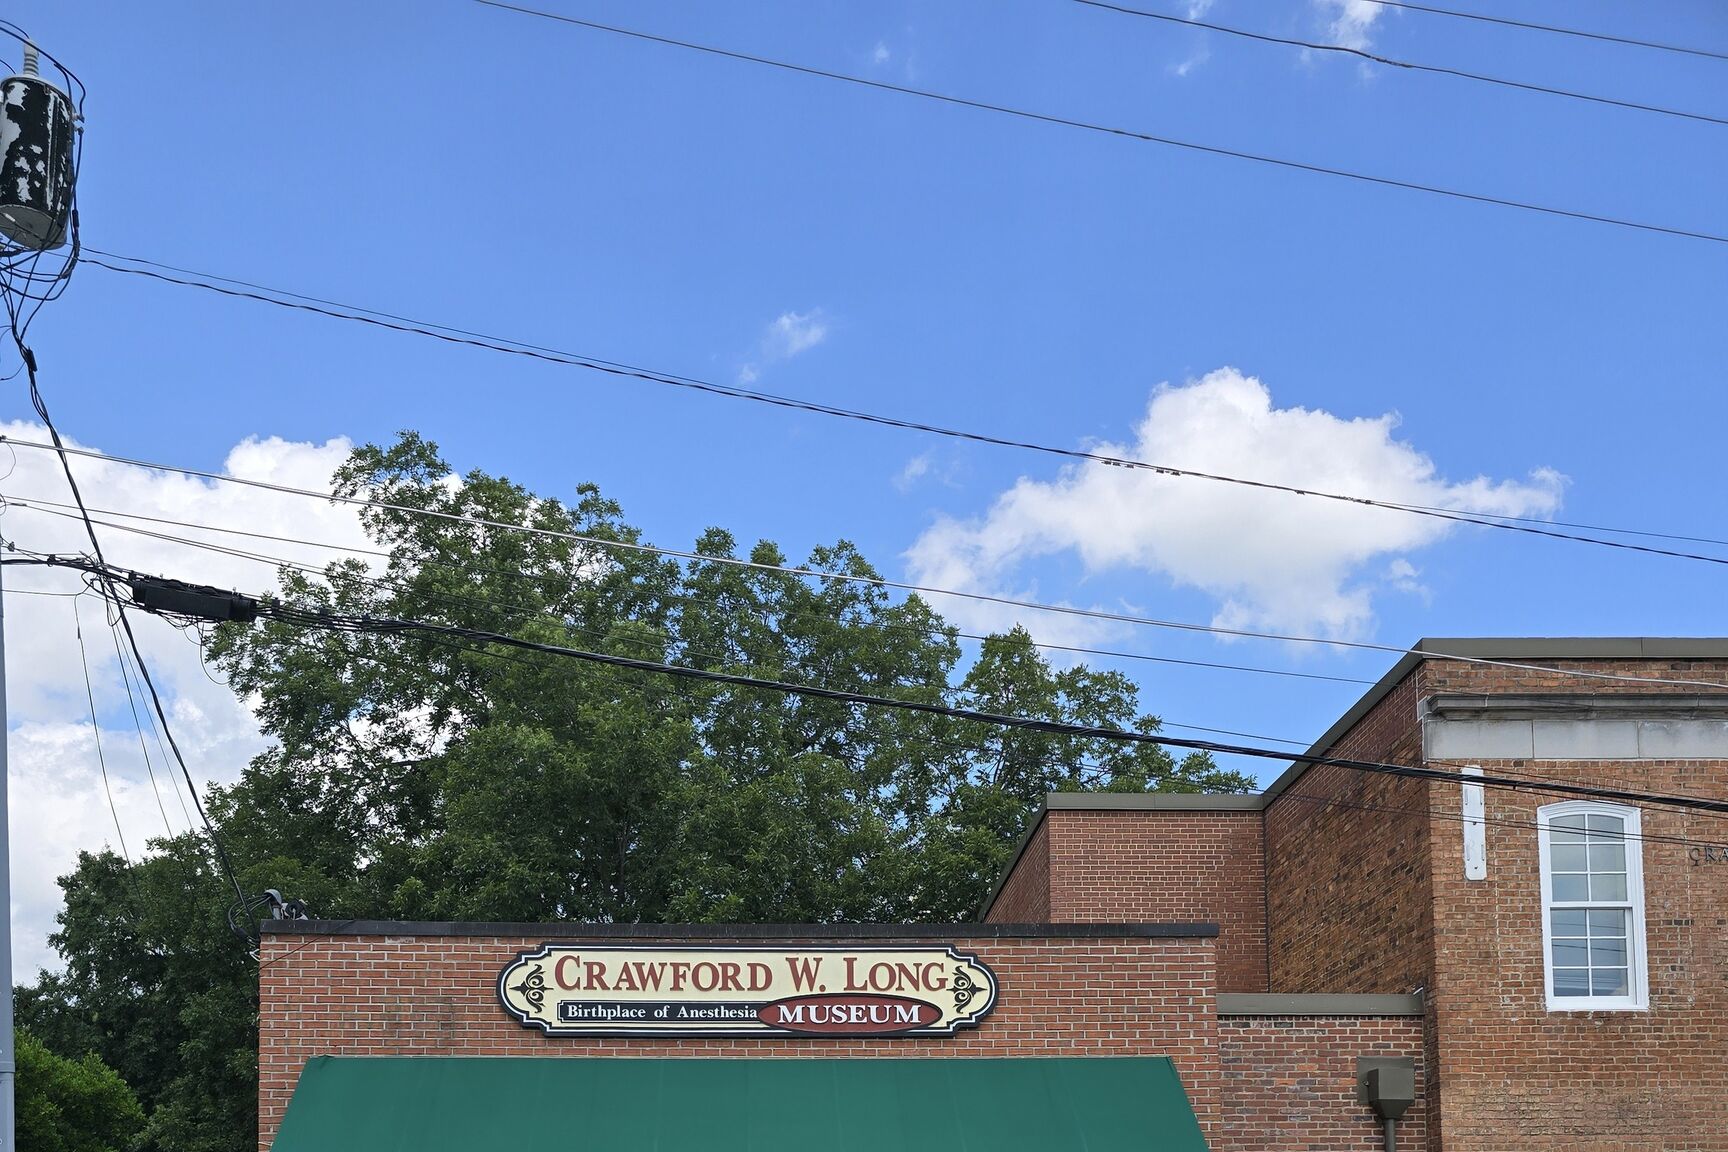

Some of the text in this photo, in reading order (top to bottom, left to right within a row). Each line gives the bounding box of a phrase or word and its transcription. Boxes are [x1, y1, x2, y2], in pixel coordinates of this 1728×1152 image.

[554, 954, 949, 992] CRAWFORD W. LONG
[567, 1004, 757, 1021] Birthplace of Anesthesia
[777, 1004, 922, 1025] MUSEUM
